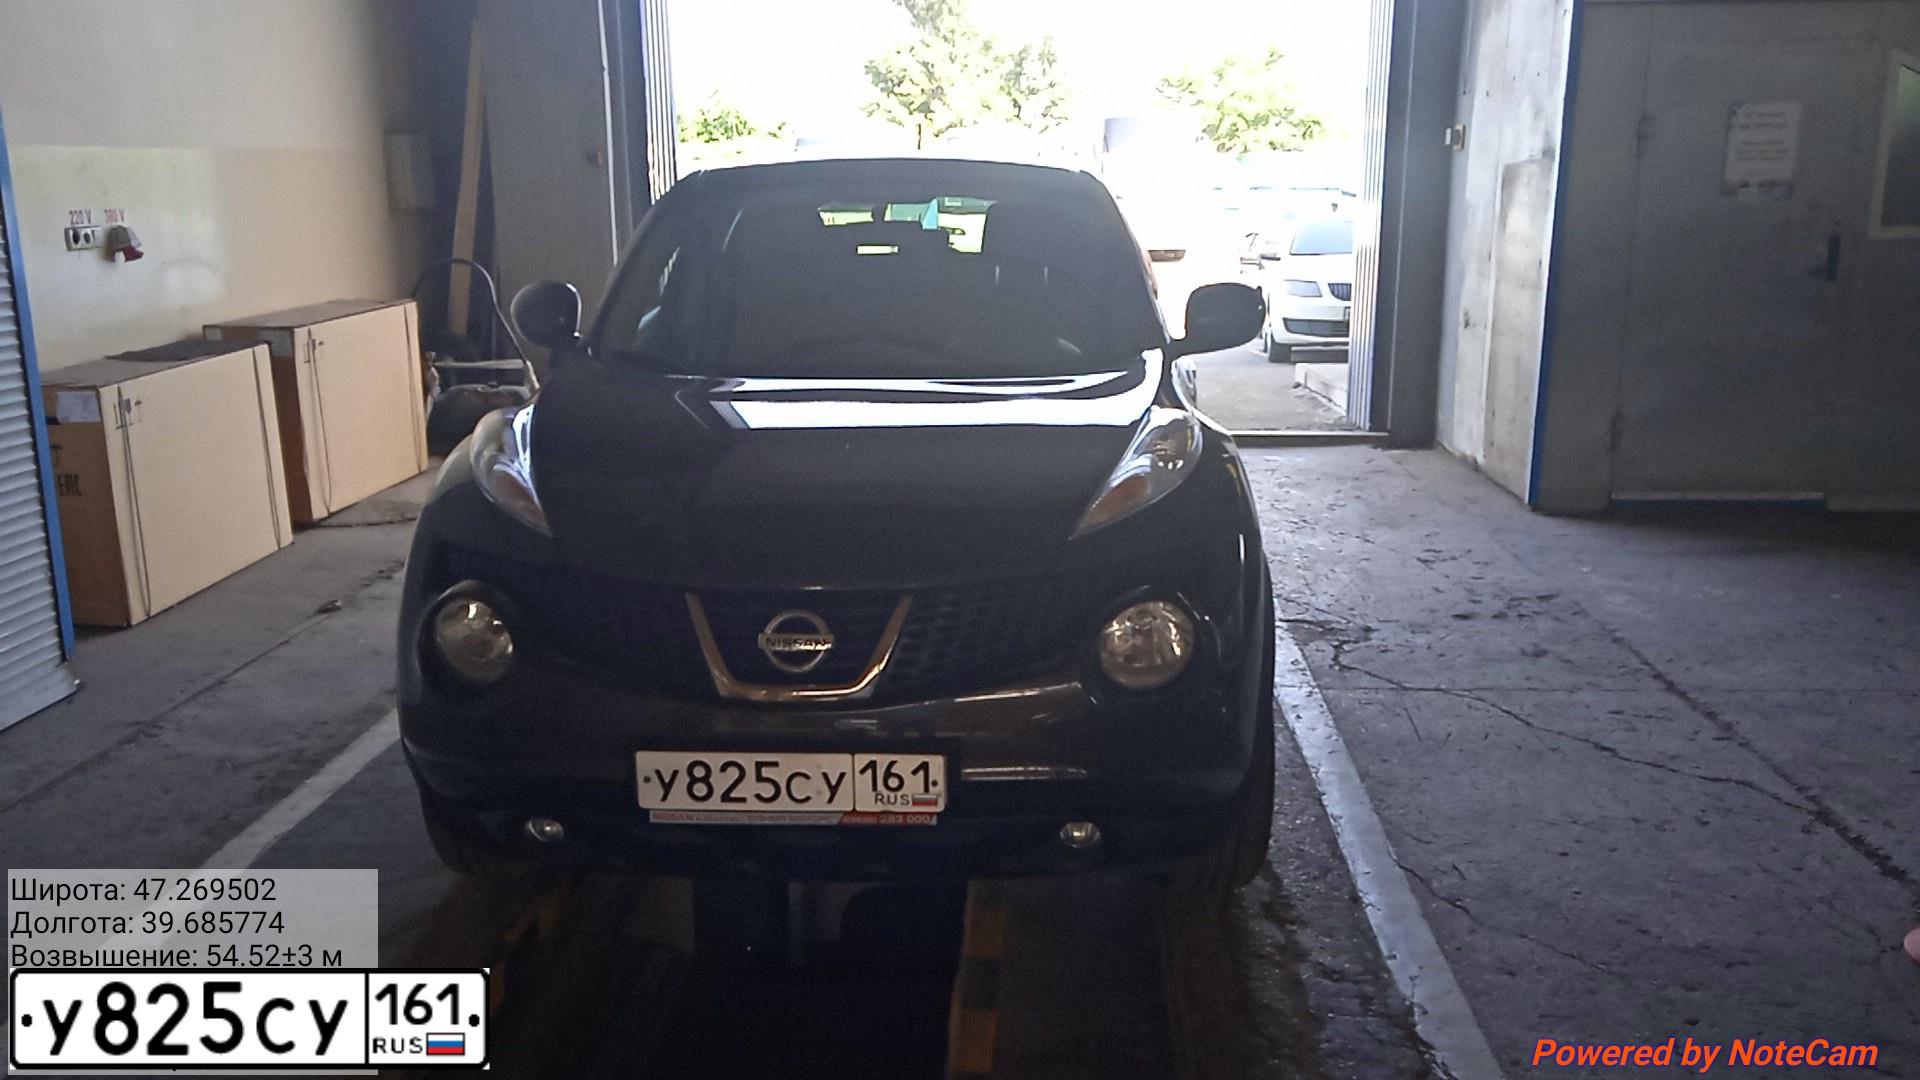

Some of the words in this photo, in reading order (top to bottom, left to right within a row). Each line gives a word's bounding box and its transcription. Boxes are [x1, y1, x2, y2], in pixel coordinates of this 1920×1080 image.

[69, 209, 85, 224] 220
[765, 637, 829, 650] NISSAN
[859, 760, 931, 793] 161
[874, 793, 911, 806] RUS
